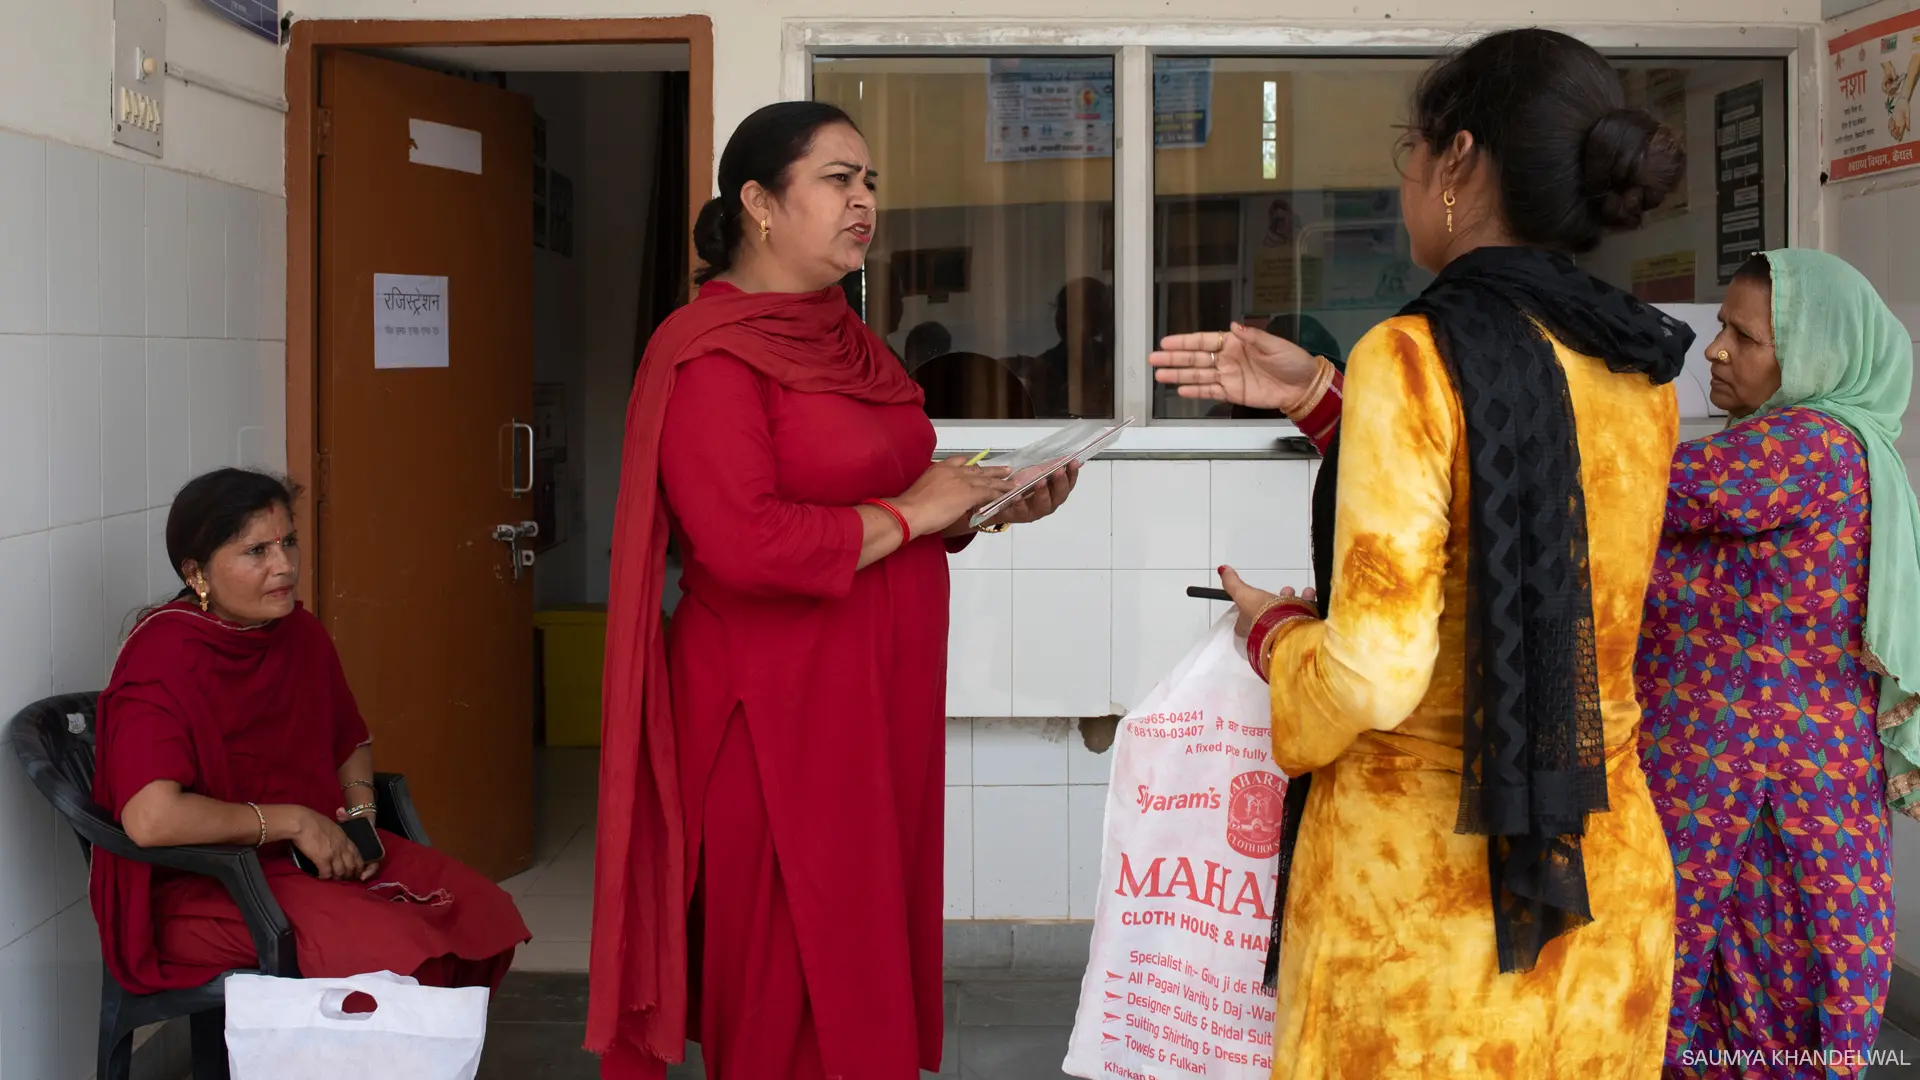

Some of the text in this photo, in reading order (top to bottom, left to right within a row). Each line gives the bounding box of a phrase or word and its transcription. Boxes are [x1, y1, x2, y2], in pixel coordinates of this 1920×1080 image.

[1838, 69, 1868, 101] नशा
[383, 286, 441, 316] रजिस्ट्रेशन
[1134, 725, 1205, 739] 88130-03407
[1185, 744, 1193, 755] A
[1196, 742, 1222, 753] fixed
[1242, 748, 1268, 762] fully
[1136, 784, 1222, 814] Siyaram's
[1228, 832, 1256, 852] CLOTH
[1121, 910, 1176, 926] CLOTH
[1180, 913, 1219, 943] HOUSE
[1223, 930, 1235, 947] &
[1129, 950, 1183, 972] Specialist
[1201, 967, 1219, 988] Guru
[1221, 976, 1230, 993] ji
[1233, 979, 1247, 994] de
[1127, 971, 1143, 984] All
[1147, 972, 1181, 996] Pagari
[1183, 984, 1210, 1011] Varity
[1212, 998, 1219, 1011] &
[1223, 1000, 1242, 1020] Daj
[1127, 992, 1272, 1046] Designer Suits & Bridal Suit
[1124, 1034, 1207, 1075] Towels & Fulkari
[1126, 1013, 1160, 1039] Suiting
[1161, 1025, 1199, 1055] Shirting
[1202, 1041, 1210, 1055] &
[1214, 1045, 1248, 1065] Dress
[1104, 1061, 1145, 1080] Kharkan
